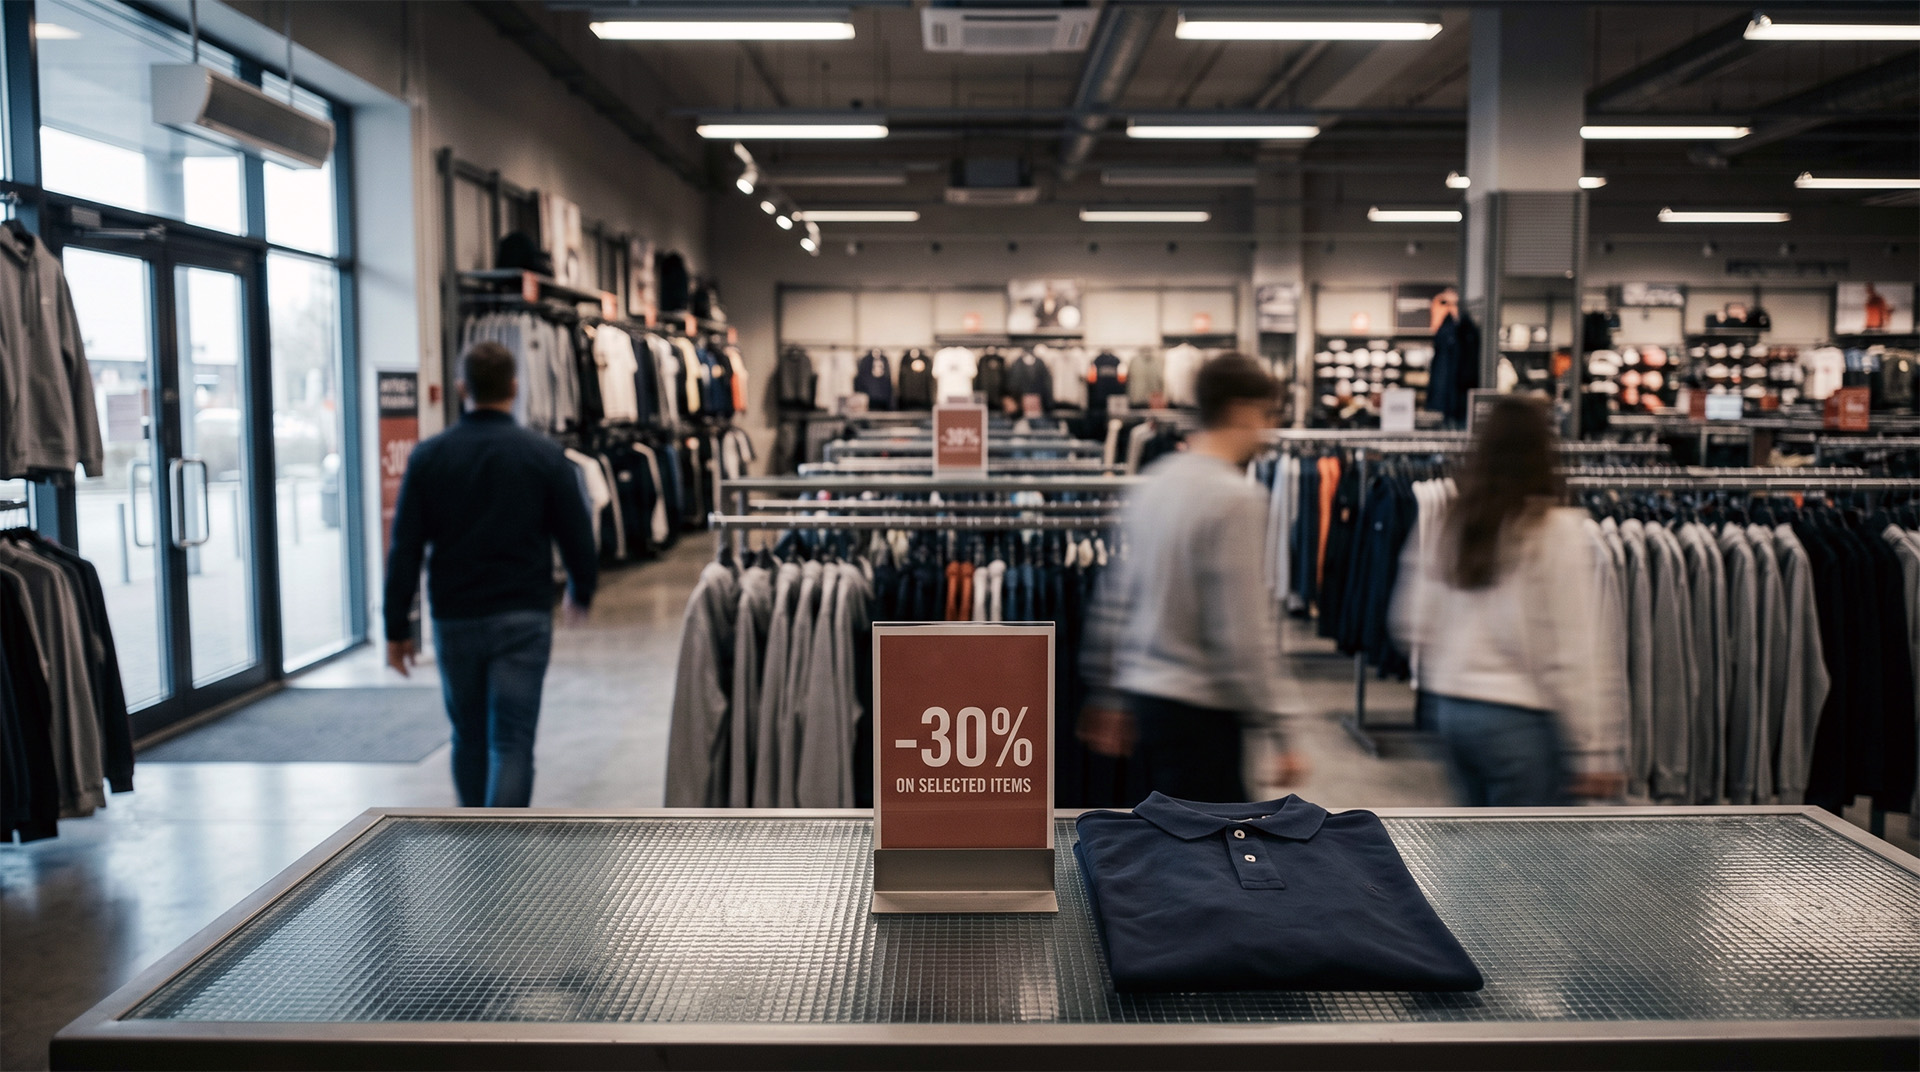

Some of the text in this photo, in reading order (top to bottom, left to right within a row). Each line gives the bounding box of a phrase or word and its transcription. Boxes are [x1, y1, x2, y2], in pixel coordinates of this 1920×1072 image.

[895, 706, 1033, 768] -30%
[896, 777, 1031, 793] ON SELECTED ITEMS
